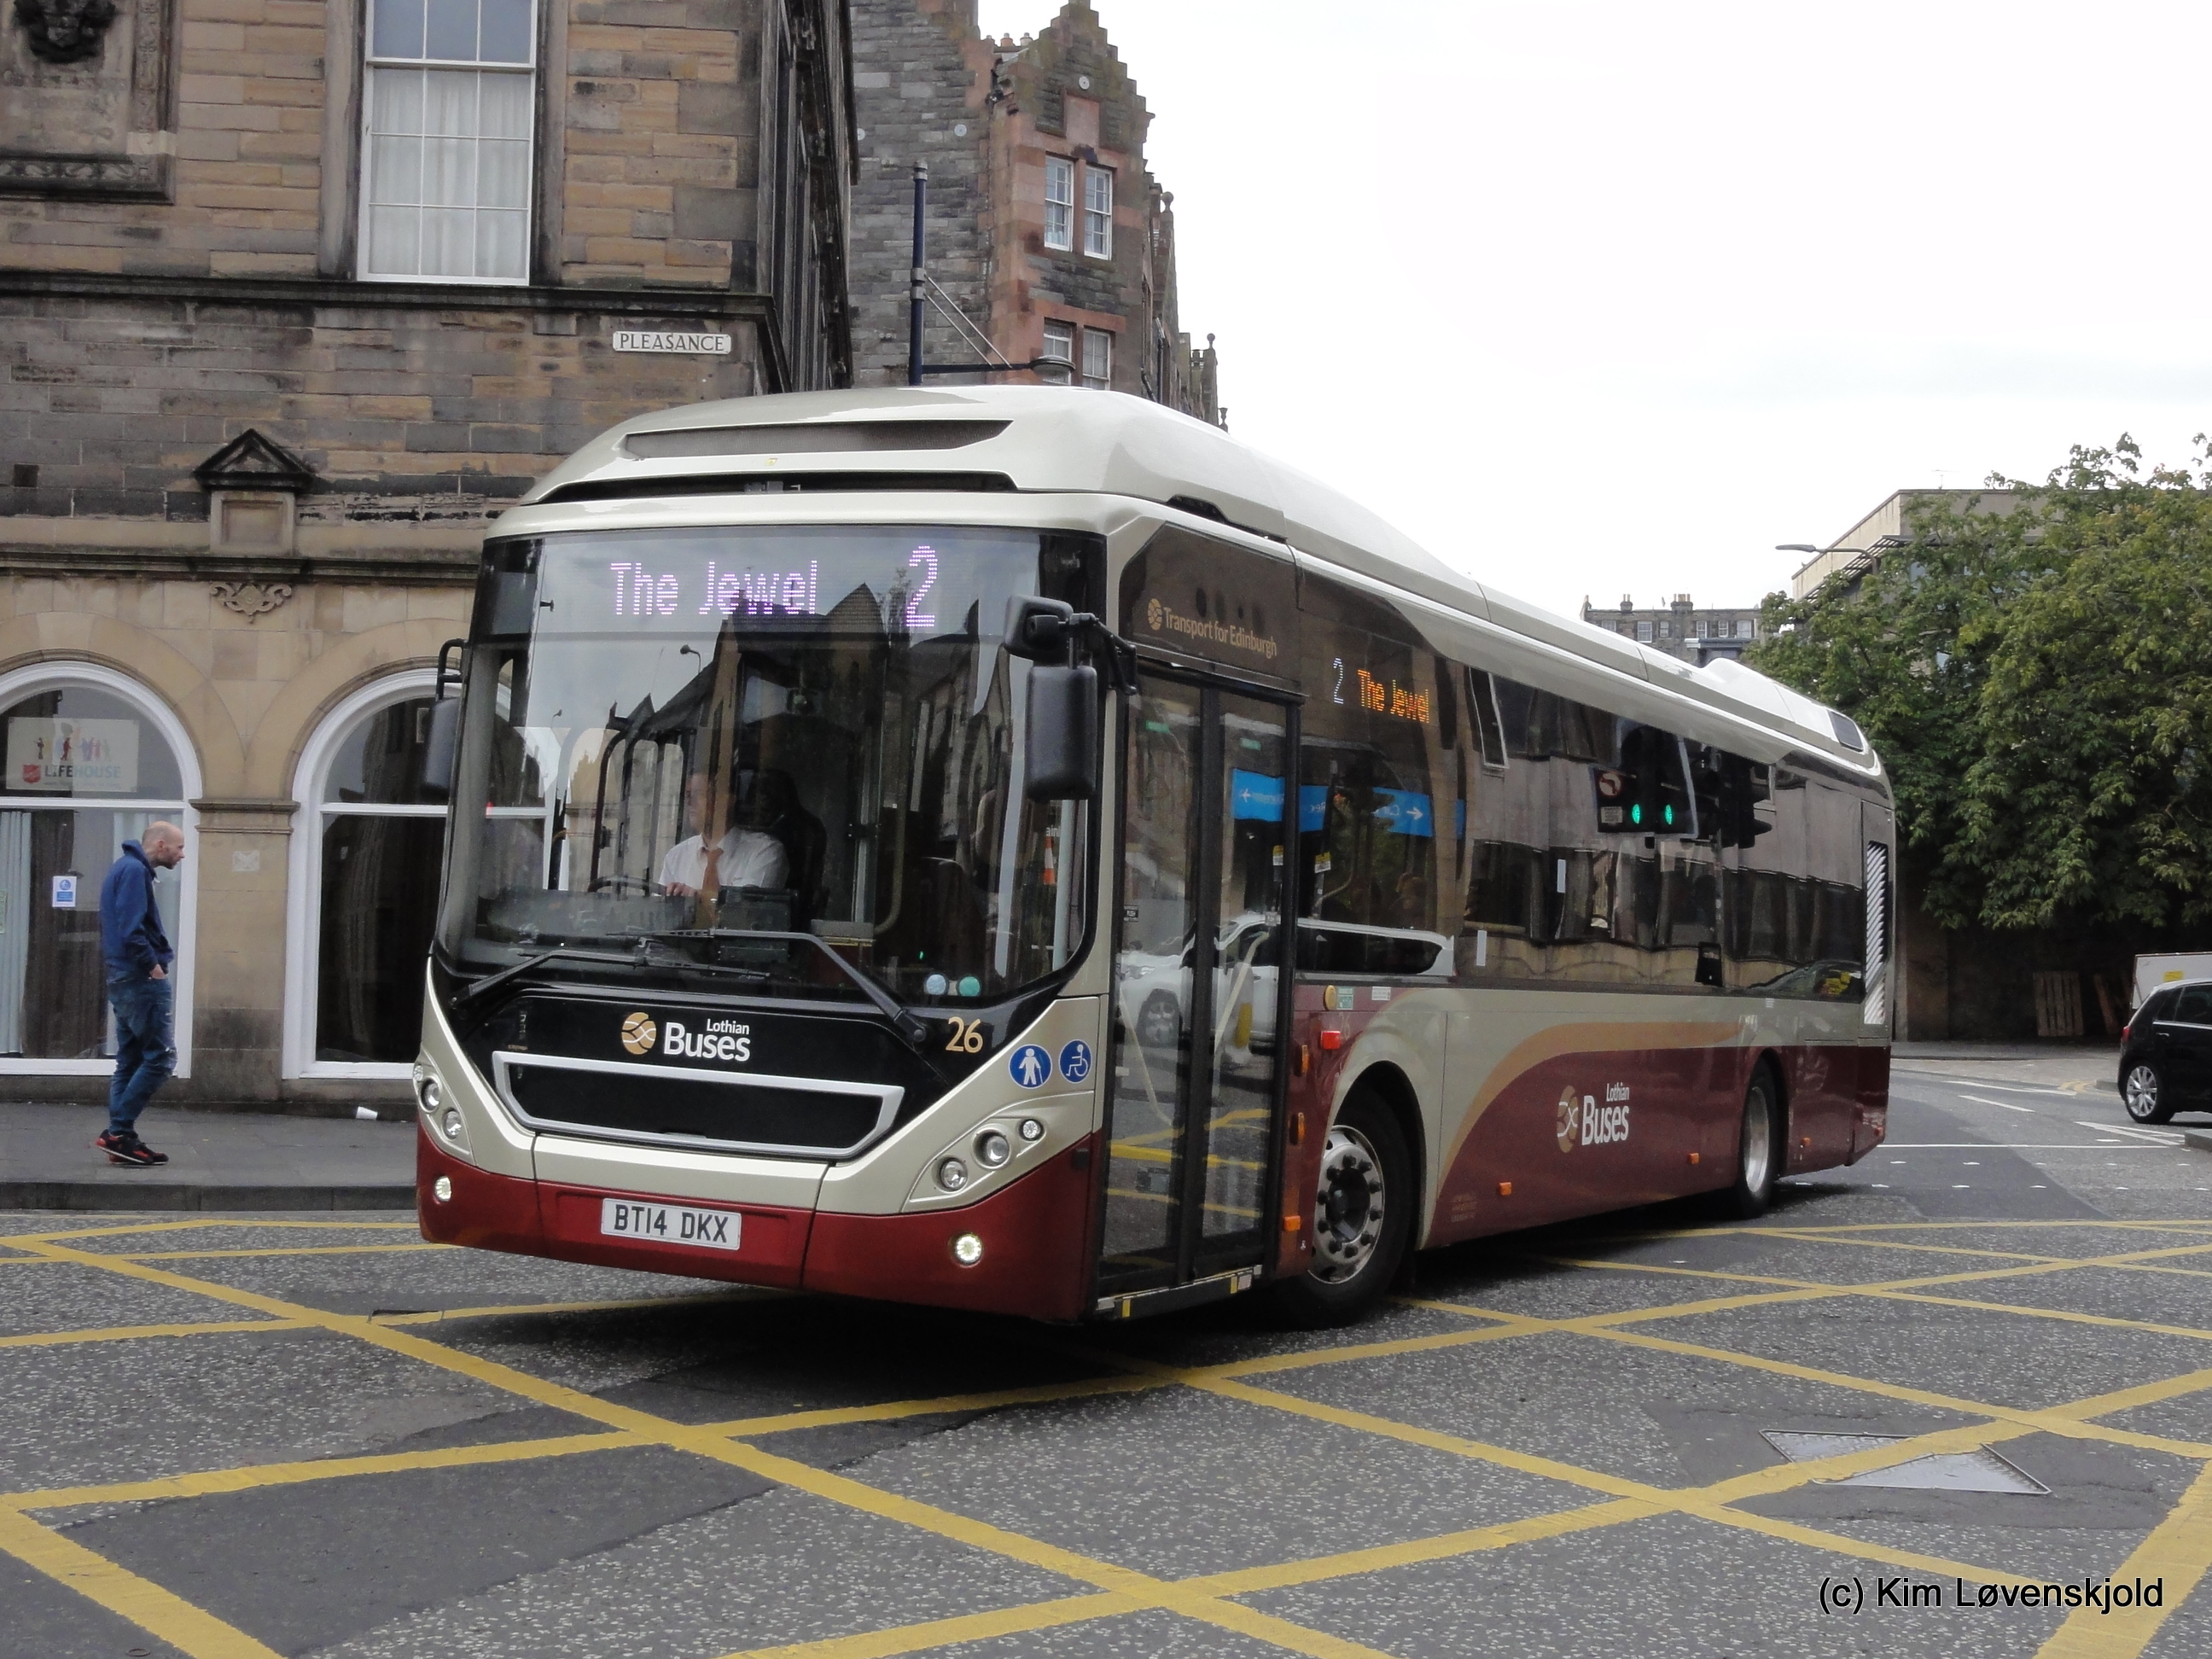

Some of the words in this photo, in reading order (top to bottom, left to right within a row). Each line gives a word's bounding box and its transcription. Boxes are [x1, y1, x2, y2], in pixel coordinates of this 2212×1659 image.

[620, 333, 725, 352] PLEASANCE
[610, 562, 678, 615] The
[699, 560, 818, 615] Jewel
[906, 545, 938, 627] 2
[1163, 607, 1213, 639] Transport
[1214, 621, 1228, 643] for
[1230, 625, 1278, 659] Edinburgh
[1333, 657, 1344, 705] 2
[1357, 669, 1384, 712] The
[1390, 679, 1429, 724] Jewel
[44, 765, 121, 778] LIFEHOUSE
[664, 1022, 750, 1062] Buses
[707, 1018, 749, 1035] Lothian
[946, 1016, 983, 1053] 26
[1606, 1082, 1630, 1102] Lothian
[1581, 1095, 1630, 1145] Buses
[614, 1204, 667, 1236] BT14
[680, 1212, 729, 1243] DKX
